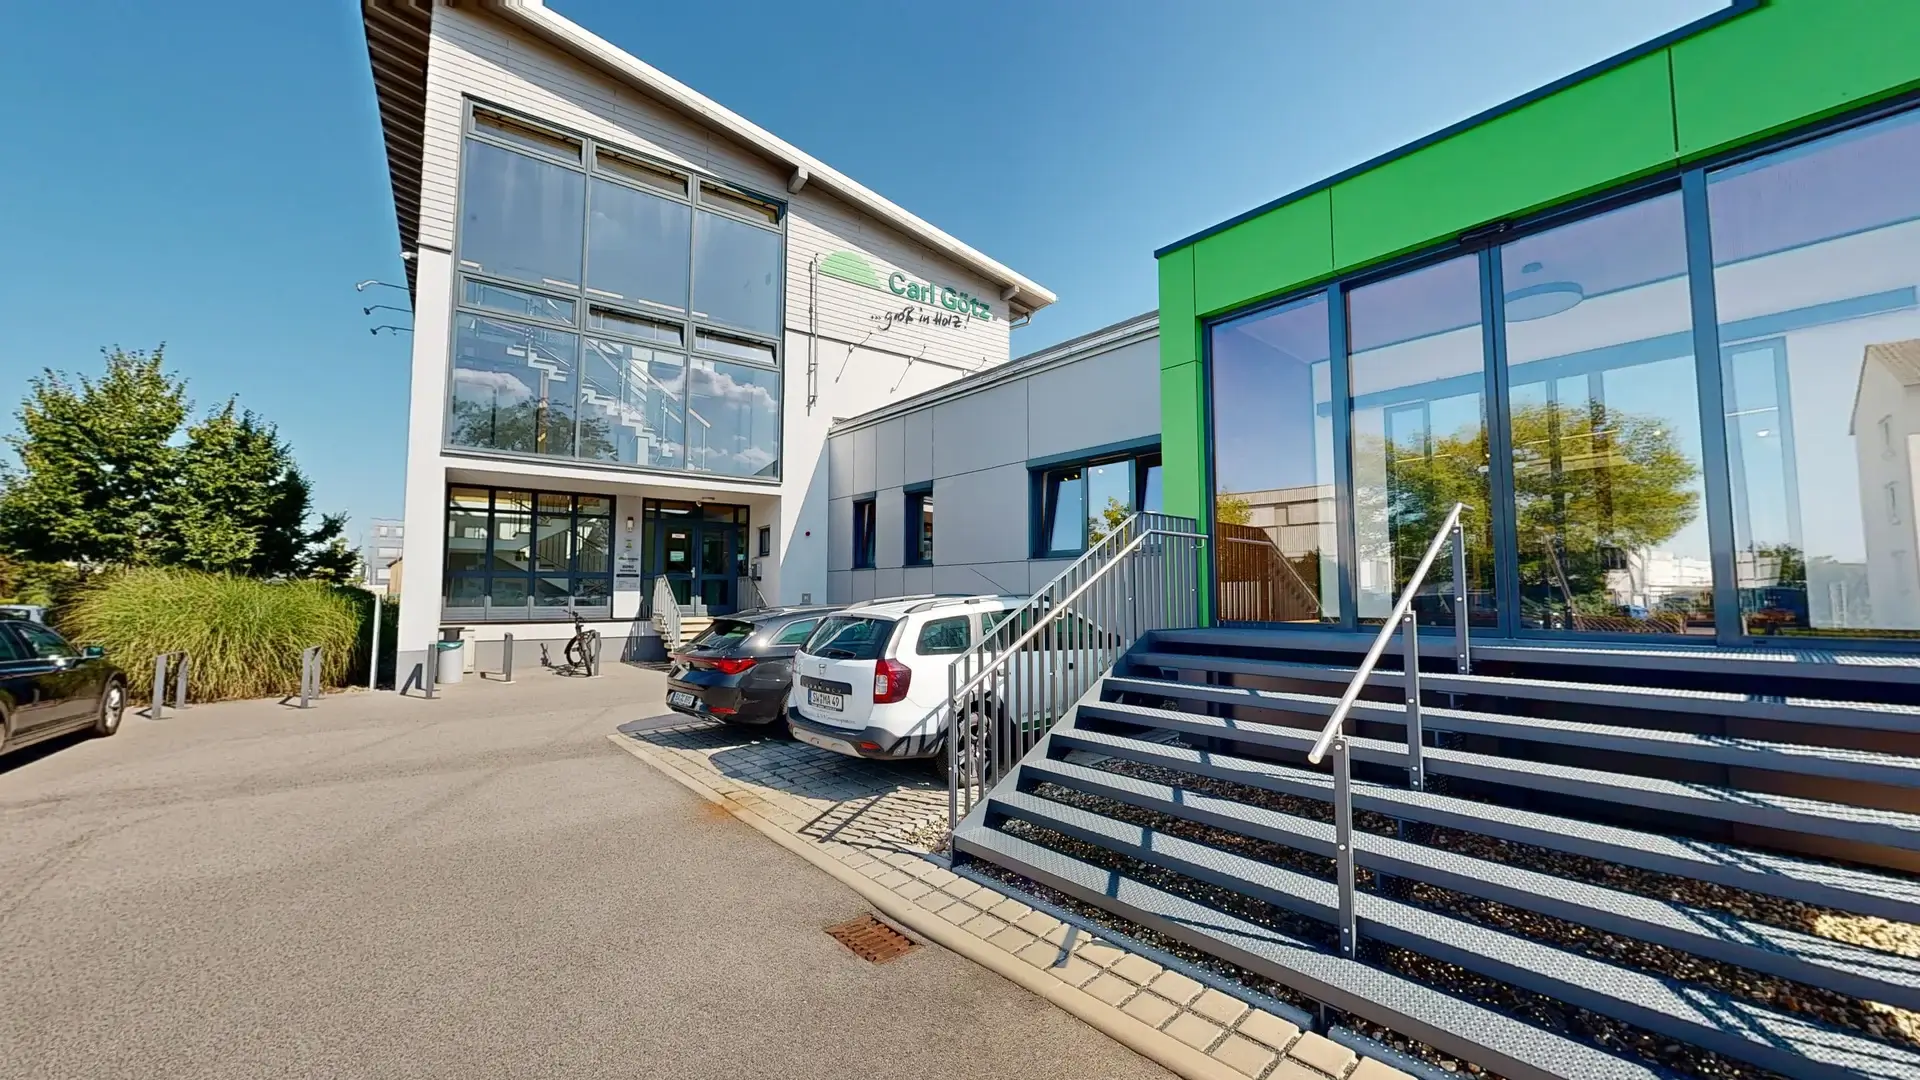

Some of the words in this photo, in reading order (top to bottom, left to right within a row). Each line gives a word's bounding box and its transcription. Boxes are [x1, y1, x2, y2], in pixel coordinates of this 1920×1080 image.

[889, 271, 936, 305] Carl
[941, 286, 992, 320] Götz
[919, 306, 931, 324] in
[933, 311, 971, 330] Holz!
